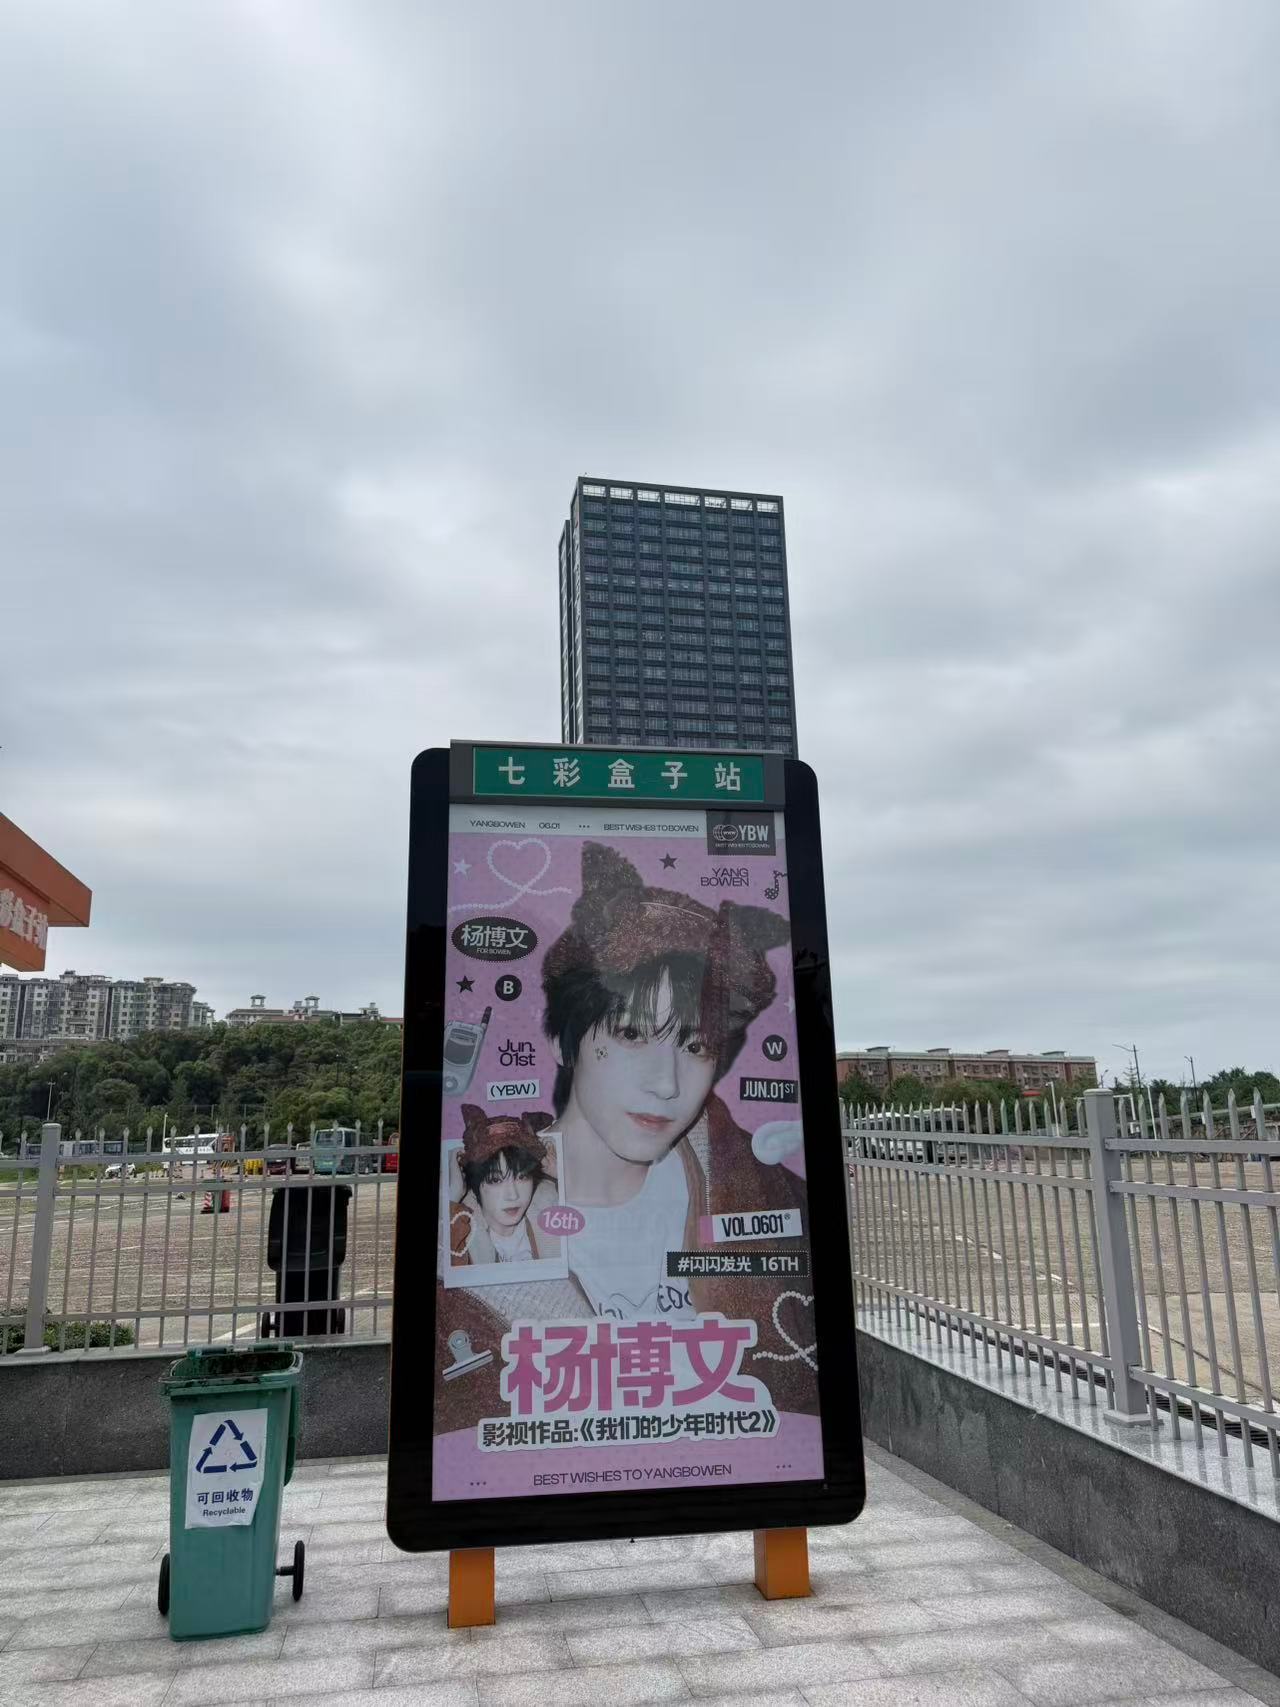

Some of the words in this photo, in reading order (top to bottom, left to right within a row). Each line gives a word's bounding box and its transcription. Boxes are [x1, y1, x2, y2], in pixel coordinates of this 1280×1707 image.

[498, 756, 741, 791] 七彩盒子站
[470, 820, 526, 829] YANGBOWEN
[603, 823, 624, 831] BEST
[738, 825, 769, 841] YBW
[712, 867, 749, 877] YANG
[700, 877, 750, 887] BOWEN
[460, 924, 528, 949] 杨博文
[503, 980, 514, 994] B
[498, 1039, 536, 1053] Jun.
[766, 1041, 783, 1055] W
[500, 1052, 536, 1067] 01st
[490, 1082, 537, 1097] (YBW)
[743, 1080, 795, 1099] JUN.01ST
[543, 1211, 579, 1230] 16th
[677, 1256, 752, 1272] #闪闪发光
[760, 1256, 799, 1272] 16TH
[507, 1319, 756, 1415] 杨博文
[533, 1473, 569, 1486] BEST
[570, 1470, 622, 1484] WISHES
[625, 1469, 643, 1480] TO
[644, 1464, 732, 1479] YANGBOWEN
[197, 1487, 254, 1505] 可回收物
[202, 1506, 246, 1517] Recyclable
